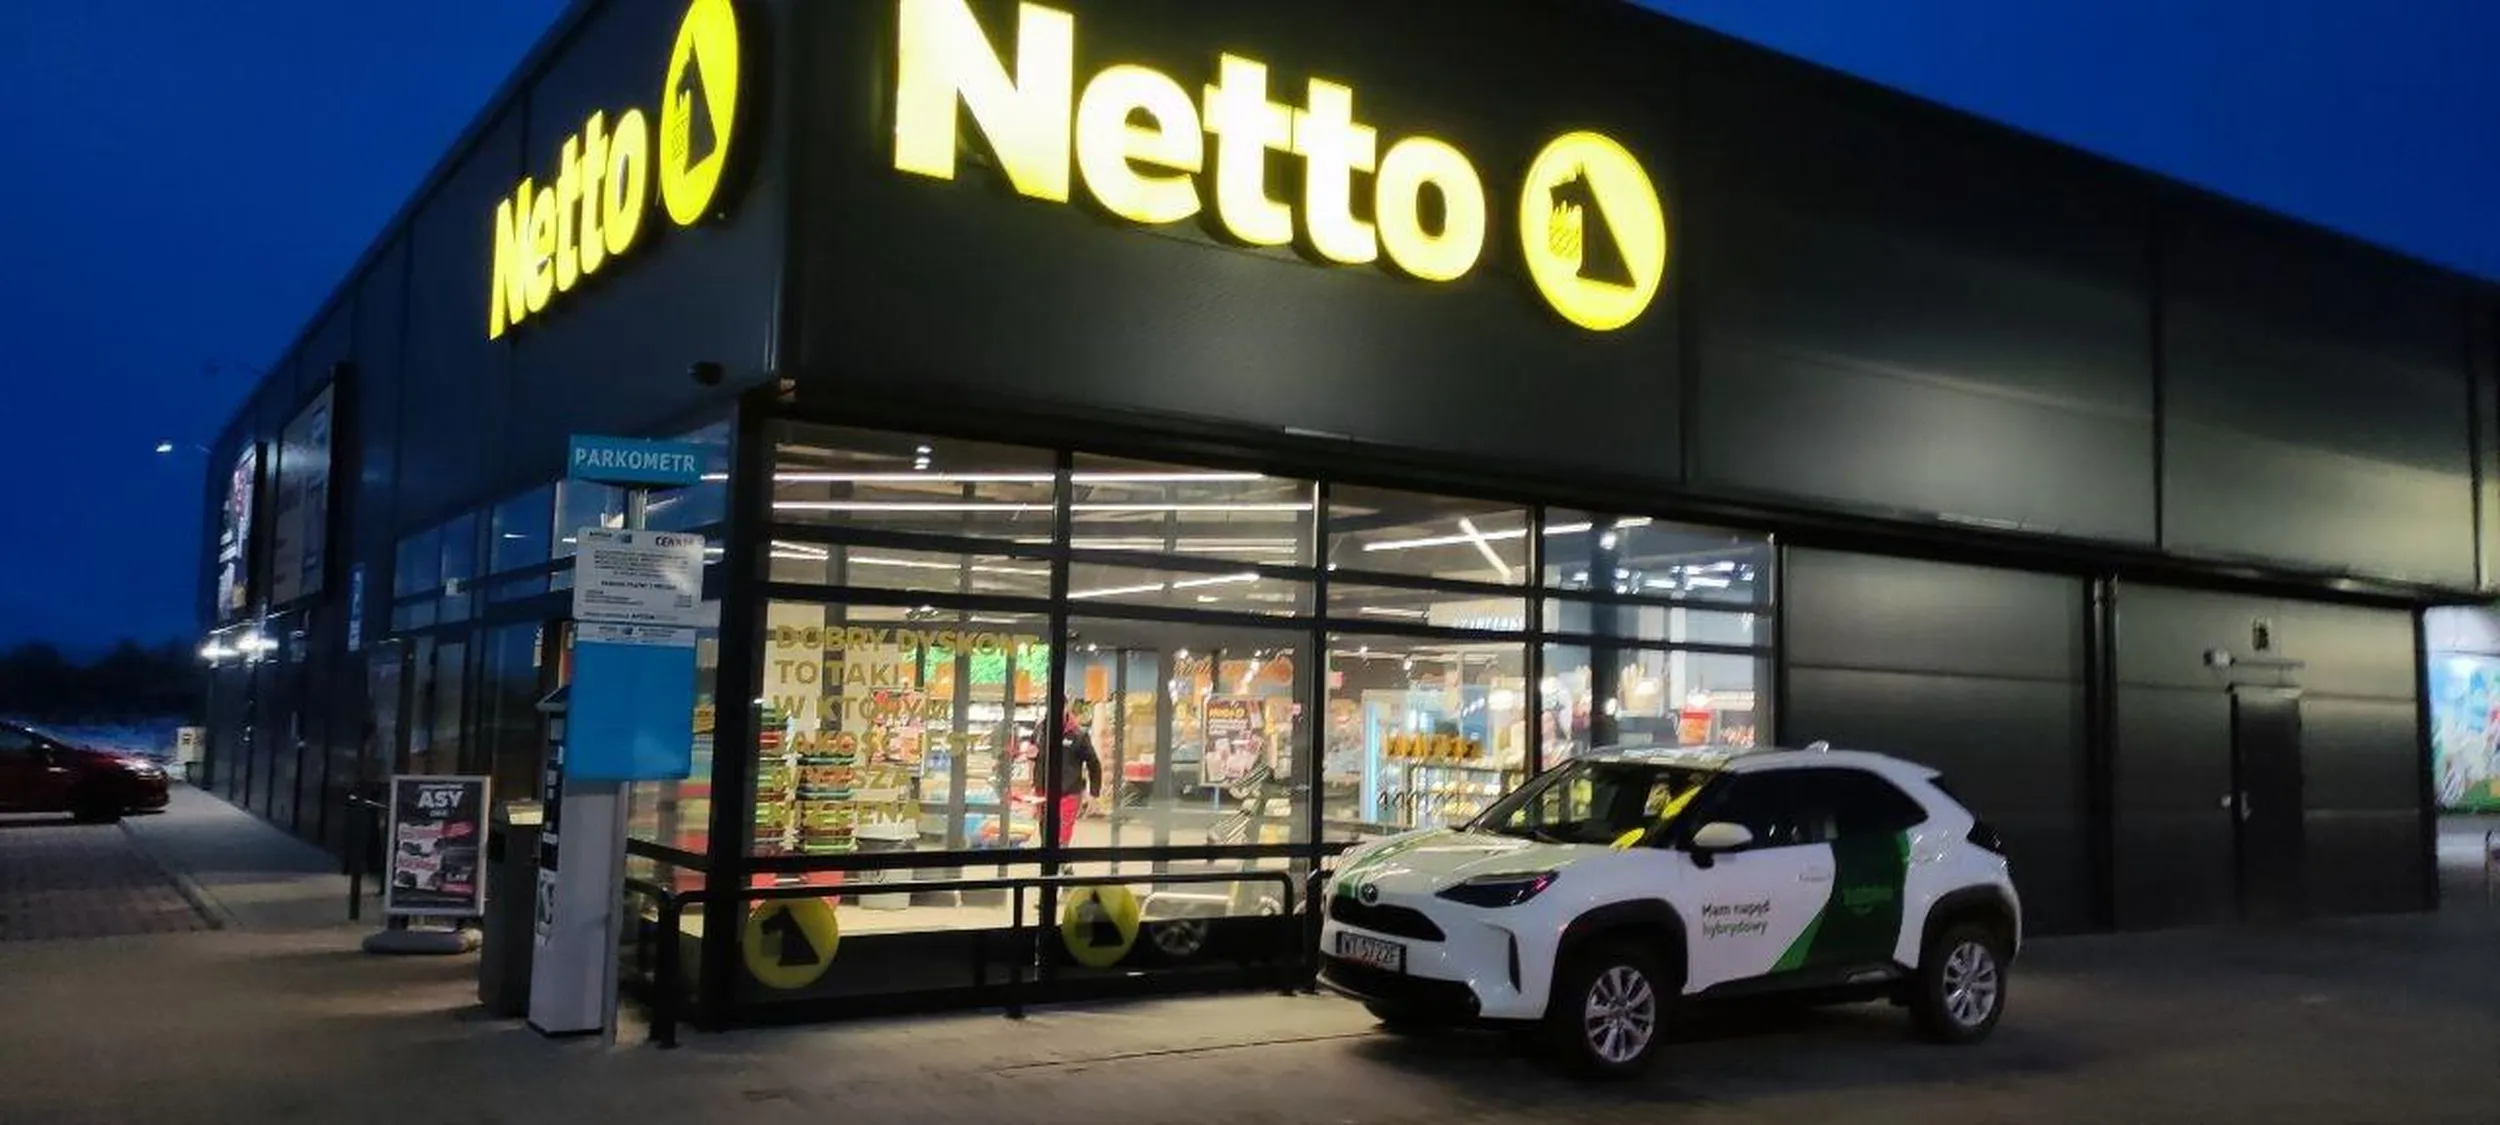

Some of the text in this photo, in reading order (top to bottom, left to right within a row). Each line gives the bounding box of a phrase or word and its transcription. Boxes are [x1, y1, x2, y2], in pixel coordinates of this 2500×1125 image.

[889, 0, 1486, 281] Netto
[490, 108, 648, 340] Netto
[575, 447, 696, 472] PARKOMETR
[775, 625, 891, 652] DOBRY
[774, 660, 900, 686] TO TAKI
[774, 695, 806, 718] W
[418, 790, 464, 808] ASY
[1702, 902, 1731, 917] Mam
[1702, 921, 1768, 939] hybrydowy
